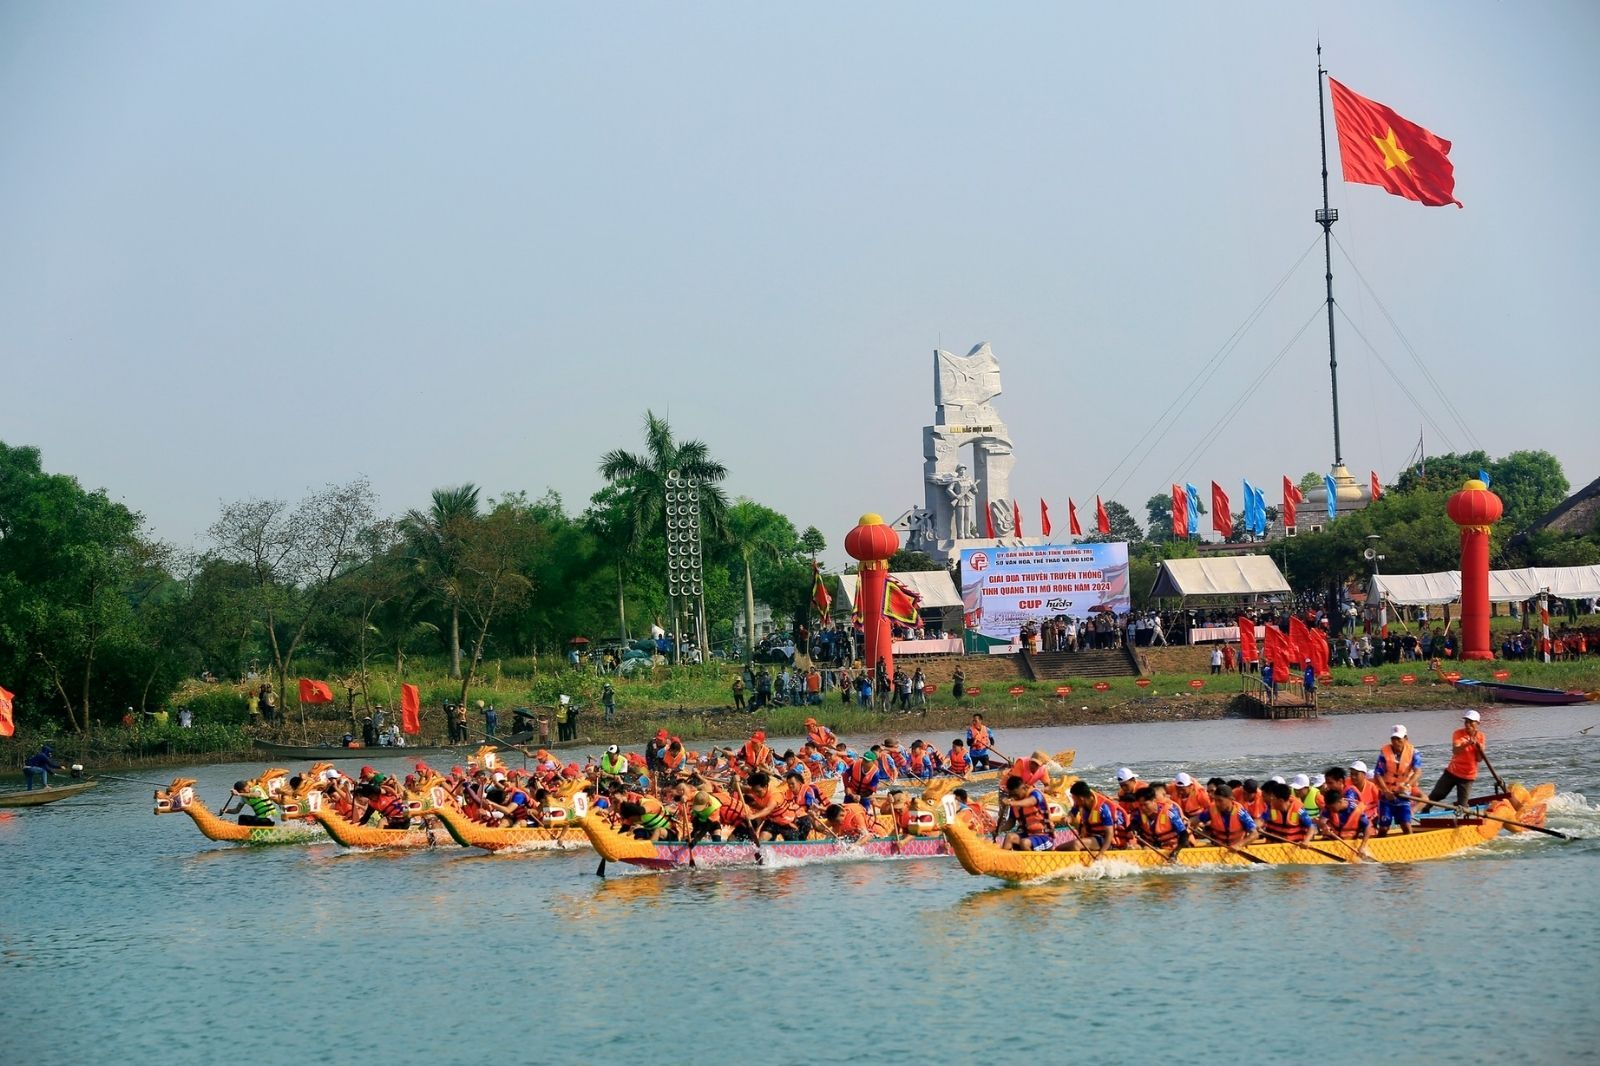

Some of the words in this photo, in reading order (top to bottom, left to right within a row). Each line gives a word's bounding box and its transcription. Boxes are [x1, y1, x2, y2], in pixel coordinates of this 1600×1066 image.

[1019, 600, 1042, 609] CUP
[434, 788, 443, 807] 8
[578, 797, 585, 810] 9
[946, 798, 955, 817] 11
